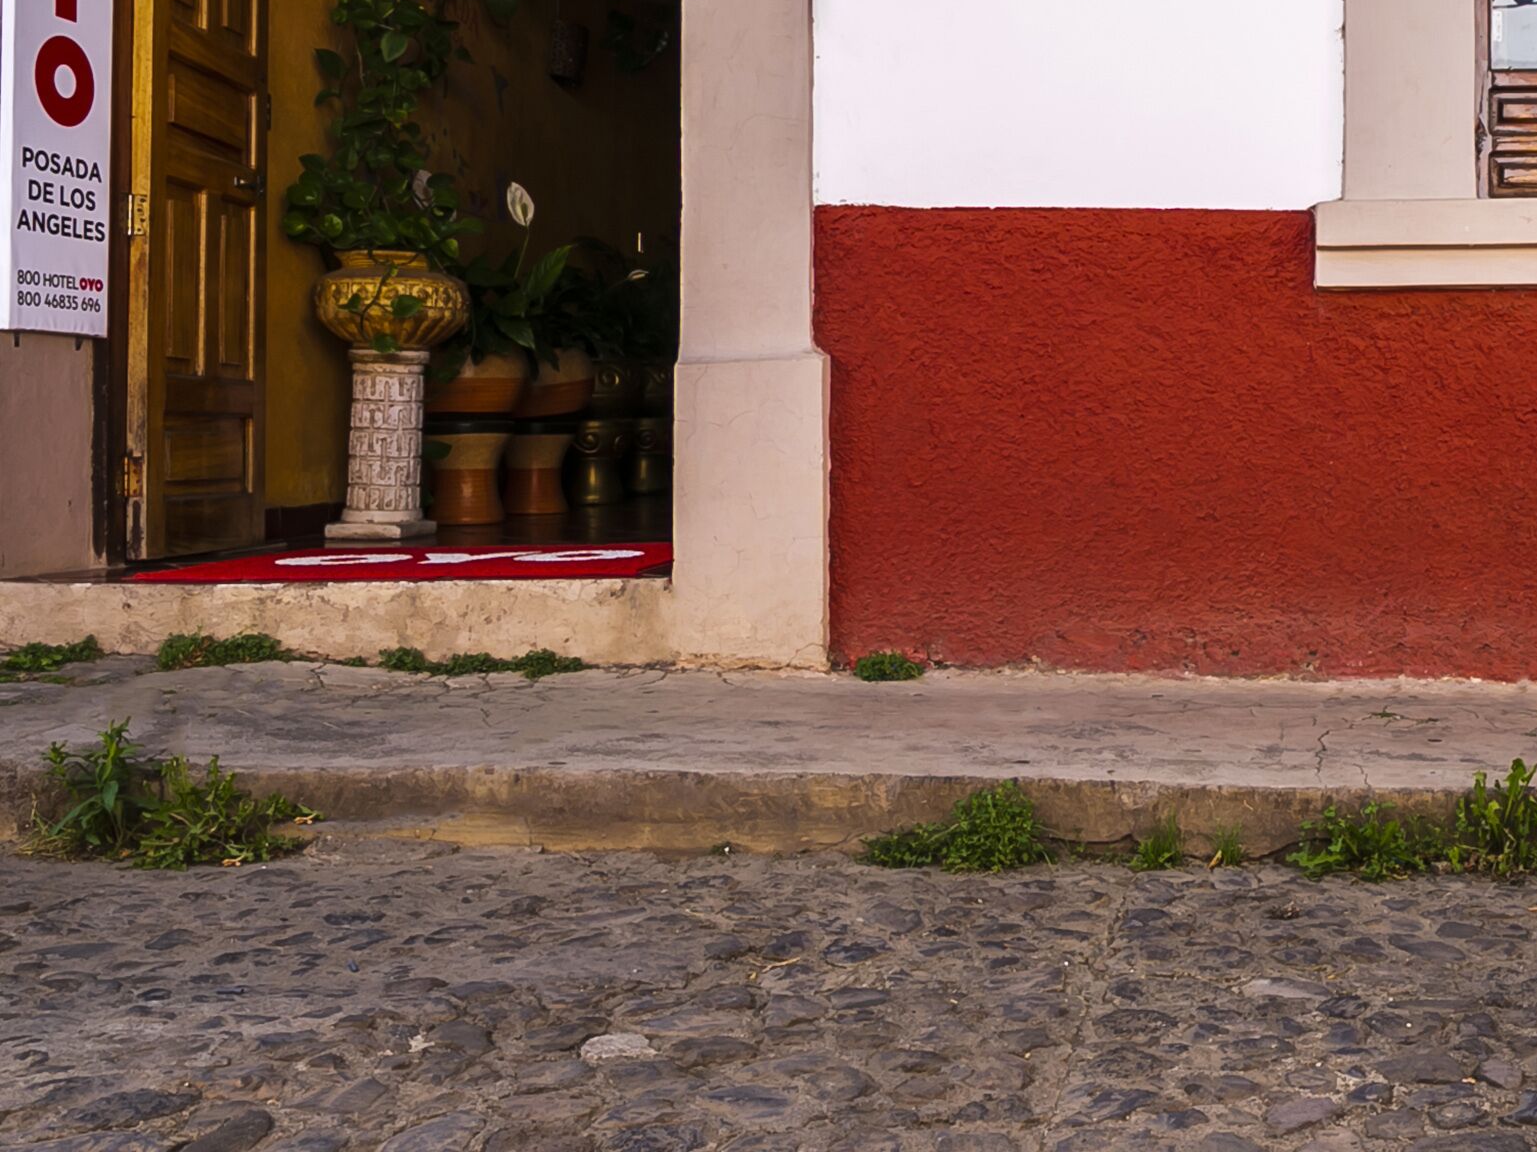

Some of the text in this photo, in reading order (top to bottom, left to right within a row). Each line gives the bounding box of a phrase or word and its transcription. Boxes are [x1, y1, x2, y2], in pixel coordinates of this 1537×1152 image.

[22, 146, 102, 183] POSADA
[28, 179, 96, 211] DE LOS
[17, 209, 106, 242] ANGELES
[17, 269, 41, 286] 800
[17, 290, 101, 312] 800 46835 696
[274, 549, 645, 566] OYO
